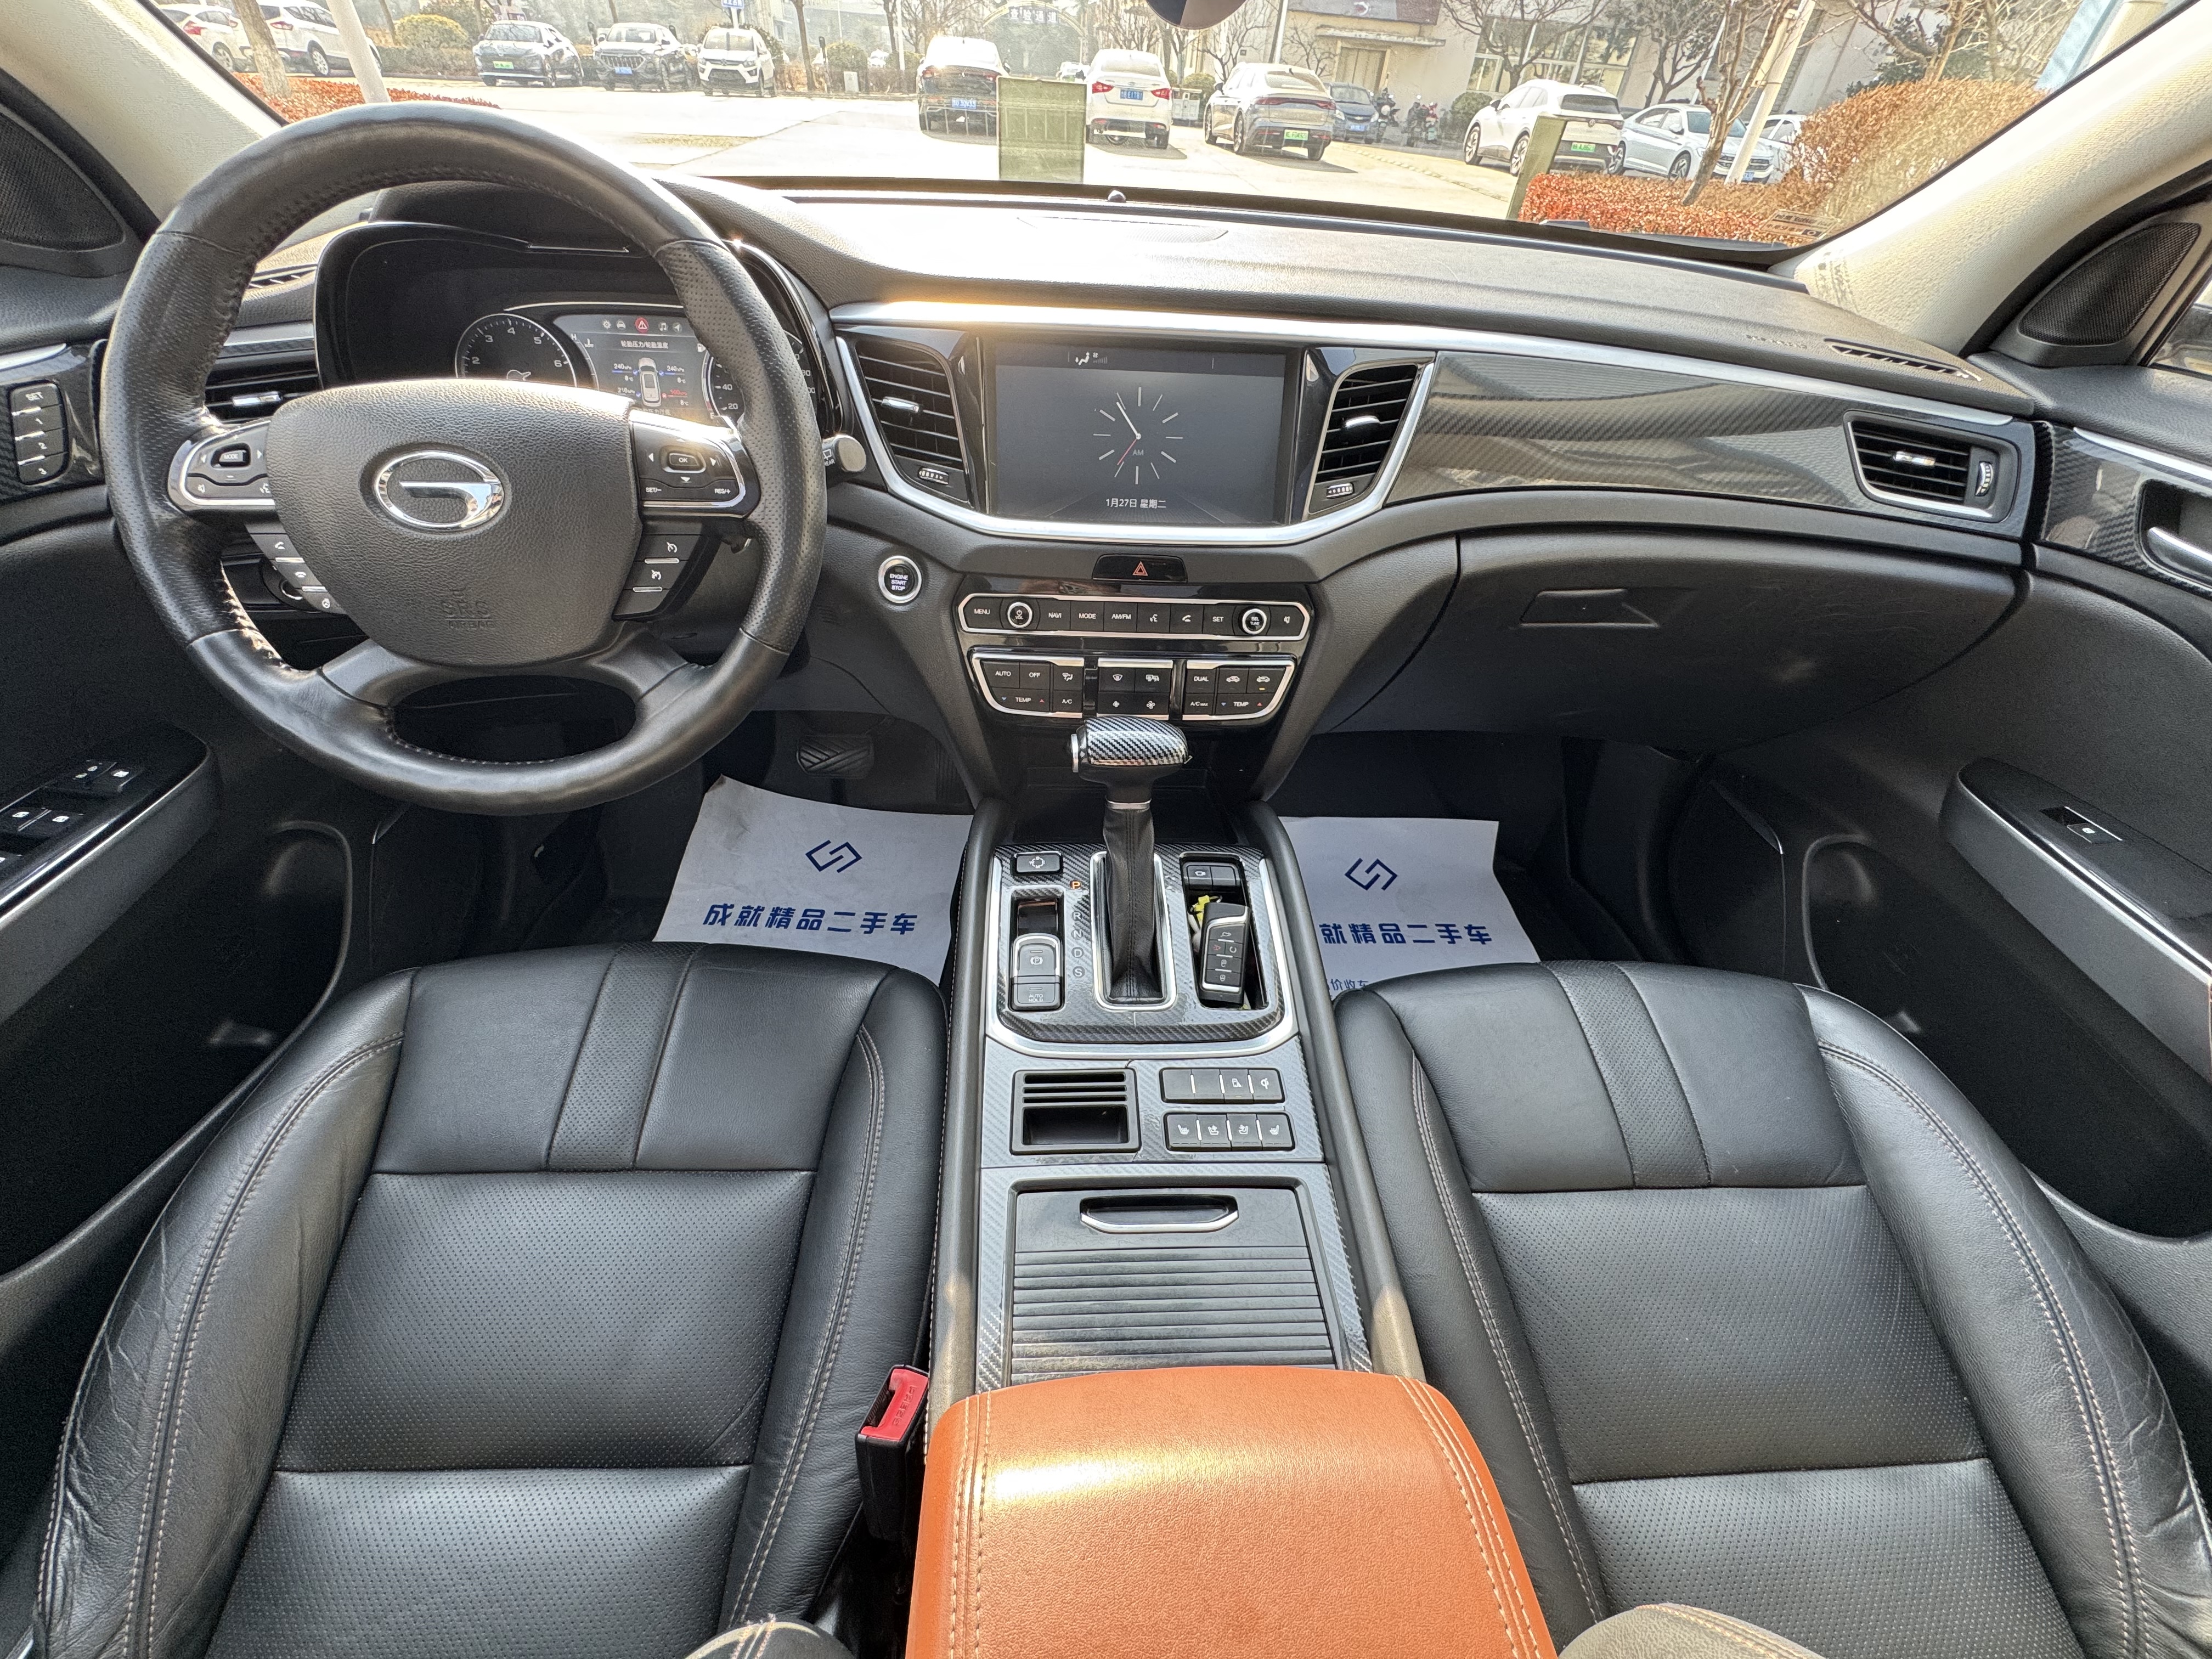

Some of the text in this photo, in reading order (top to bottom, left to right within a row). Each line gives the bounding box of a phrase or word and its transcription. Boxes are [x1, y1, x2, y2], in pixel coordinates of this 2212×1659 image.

[485, 335, 493, 343] 3
[25, 392, 44, 401] SET
[1105, 498, 1167, 509] 1月27日 星期二
[1072, 881, 1081, 889] P
[703, 903, 918, 935] 成就精品二手车
[1073, 912, 1081, 920] R
[1318, 923, 1493, 945] 就精品二手车
[1074, 949, 1082, 957] D
[1075, 968, 1082, 977] S
[892, 1385, 918, 1426] PRESS
